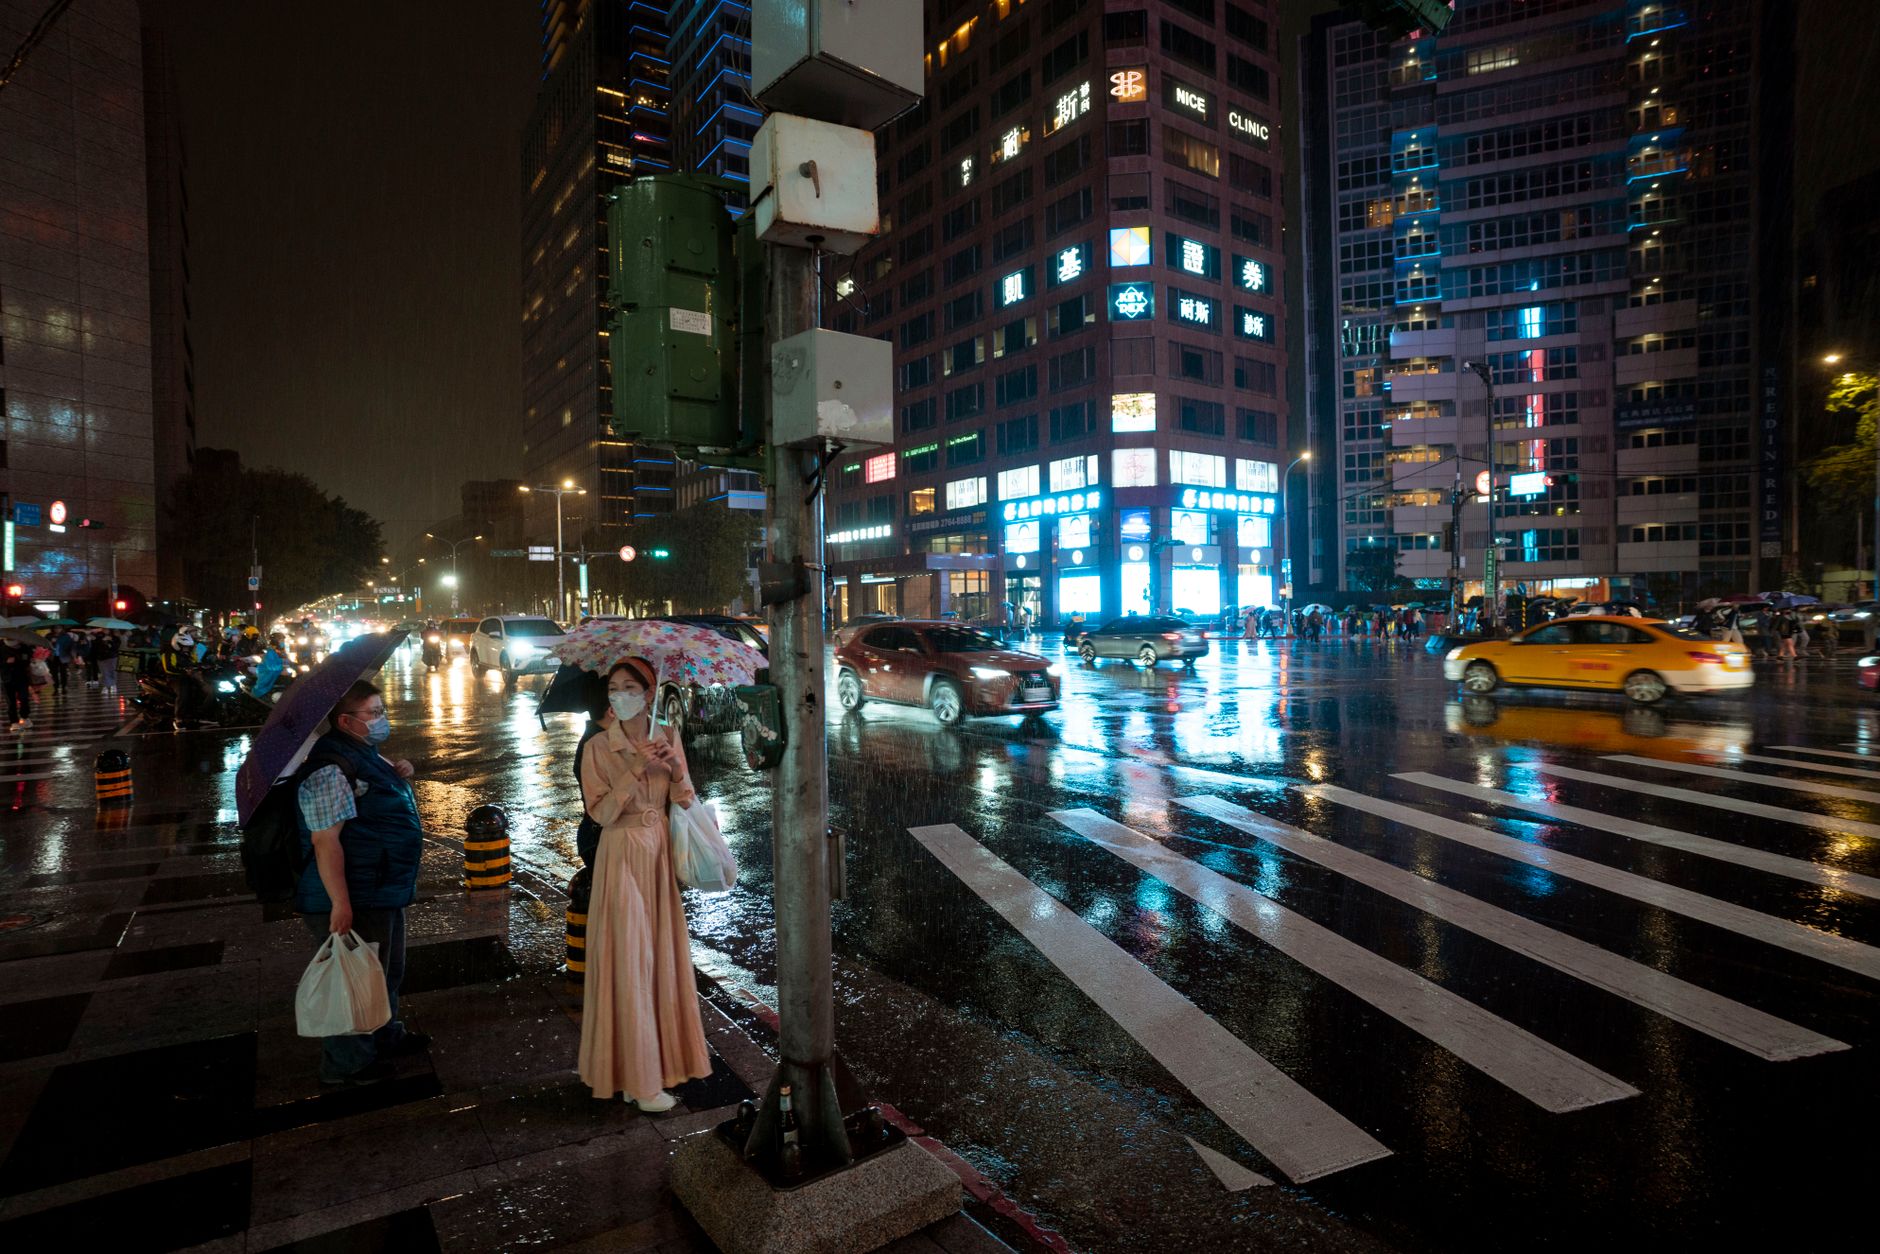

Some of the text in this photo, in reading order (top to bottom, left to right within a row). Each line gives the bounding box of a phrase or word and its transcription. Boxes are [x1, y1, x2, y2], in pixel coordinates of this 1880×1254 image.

[1176, 87, 1269, 141] NICE CLINIC
[1119, 291, 1144, 302] KEY
[1179, 298, 1264, 338] 耐斯 診所
